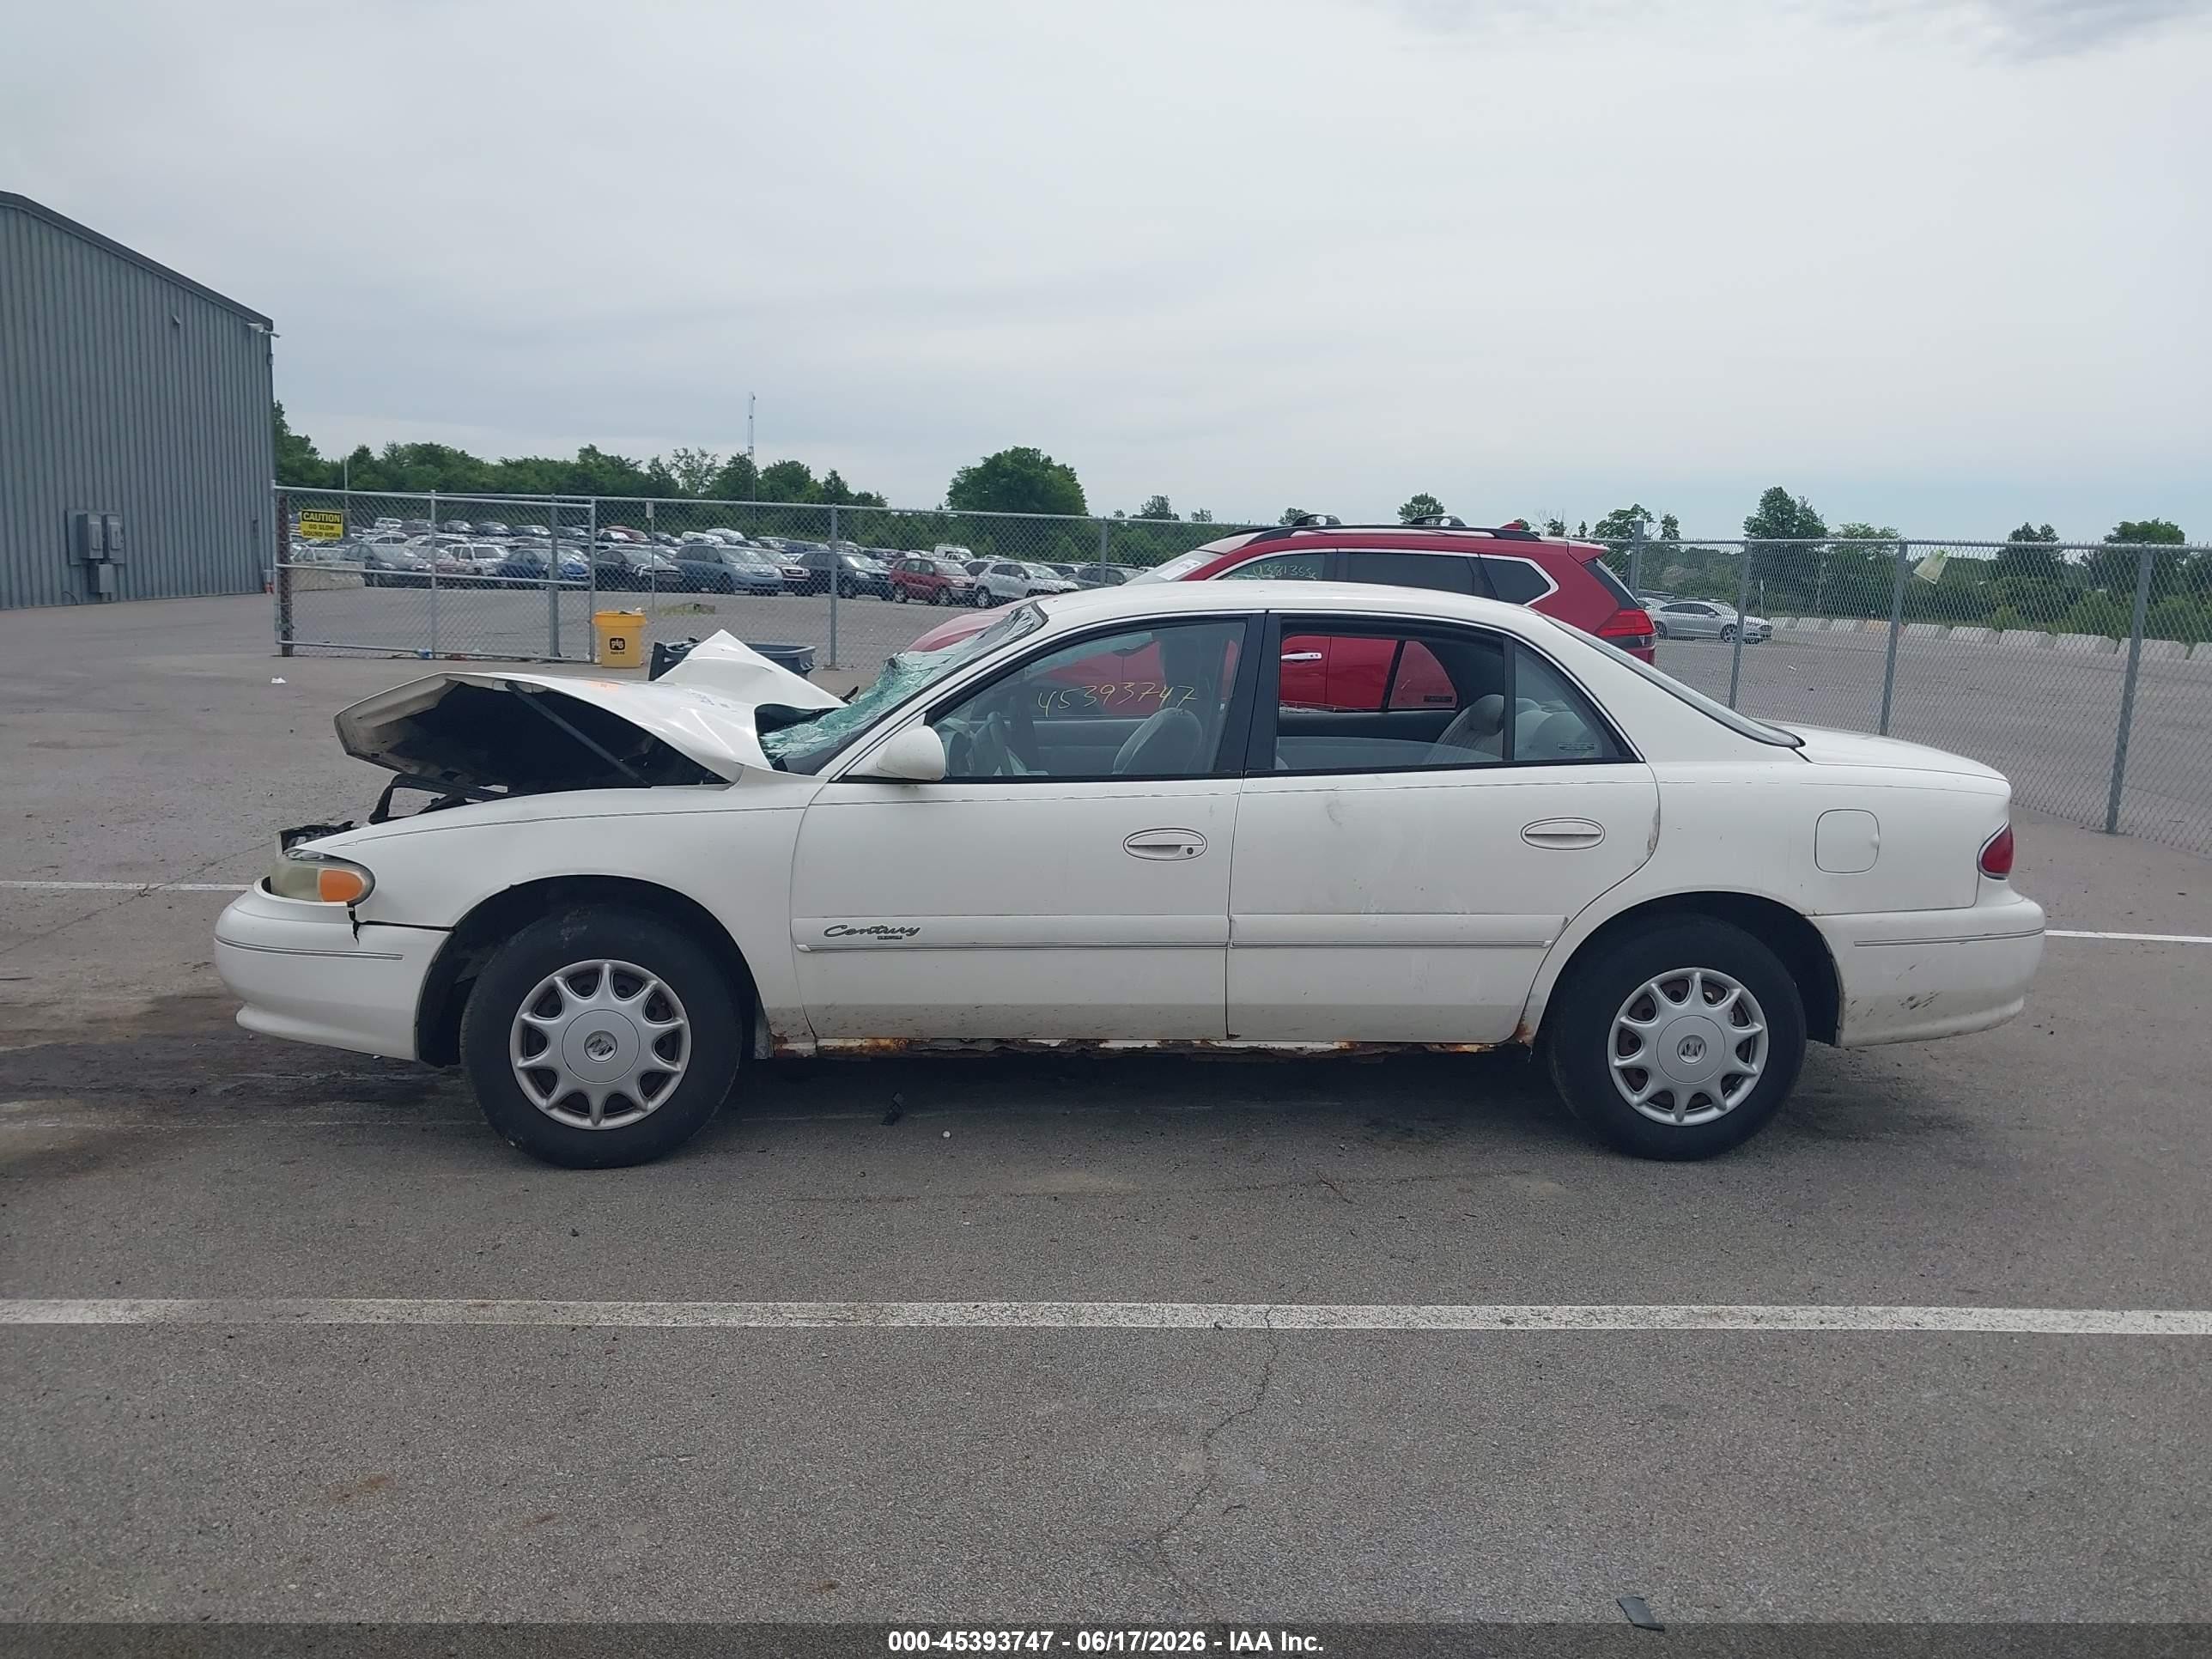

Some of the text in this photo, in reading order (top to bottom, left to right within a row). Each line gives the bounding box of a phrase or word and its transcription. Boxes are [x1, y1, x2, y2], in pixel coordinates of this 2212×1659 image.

[303, 512, 340, 523] CAUTION
[1037, 682, 1199, 719] 45393747
[823, 924, 921, 937] Century
